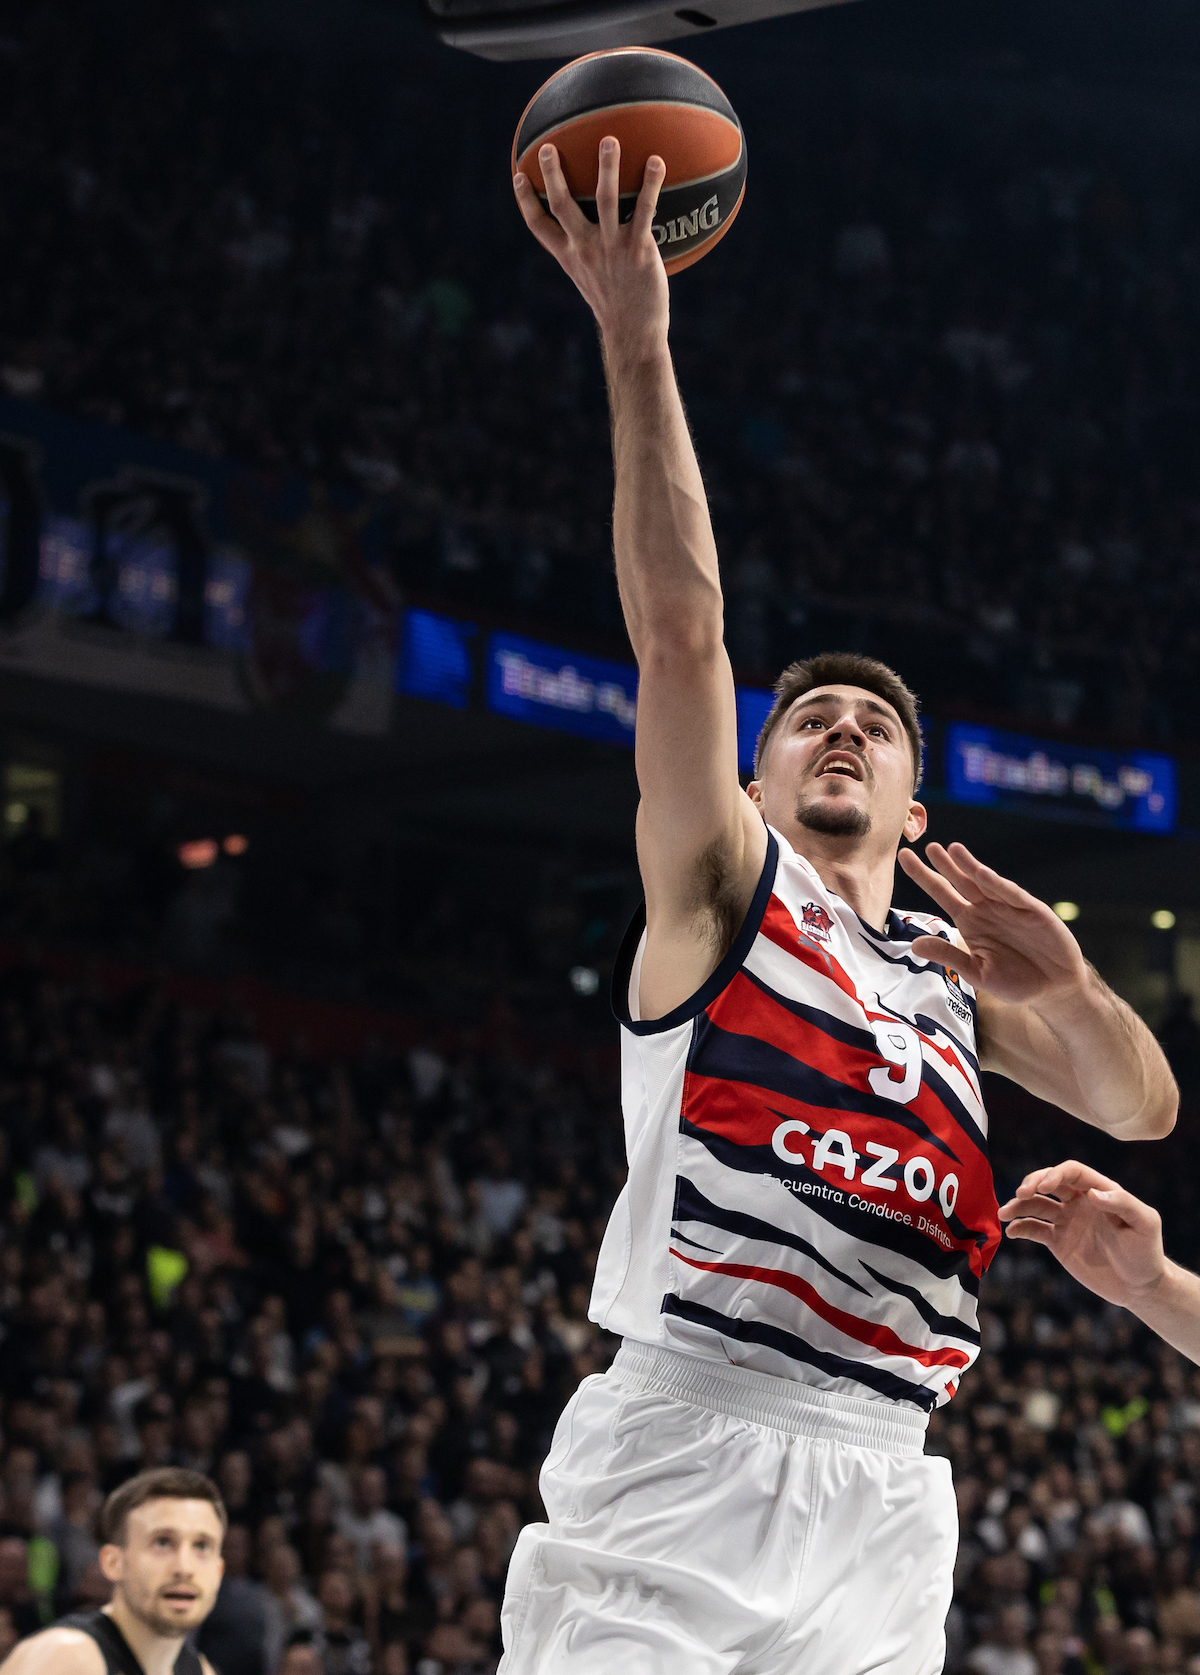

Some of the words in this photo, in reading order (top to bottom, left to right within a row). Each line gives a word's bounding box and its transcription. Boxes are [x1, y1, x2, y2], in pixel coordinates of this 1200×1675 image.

[947, 997, 972, 1024] neteam
[868, 1018, 922, 1106] 9
[762, 1172, 846, 1206] Encuentra.
[848, 1193, 914, 1227] Conduce.
[771, 1119, 959, 1219] CAZOO
